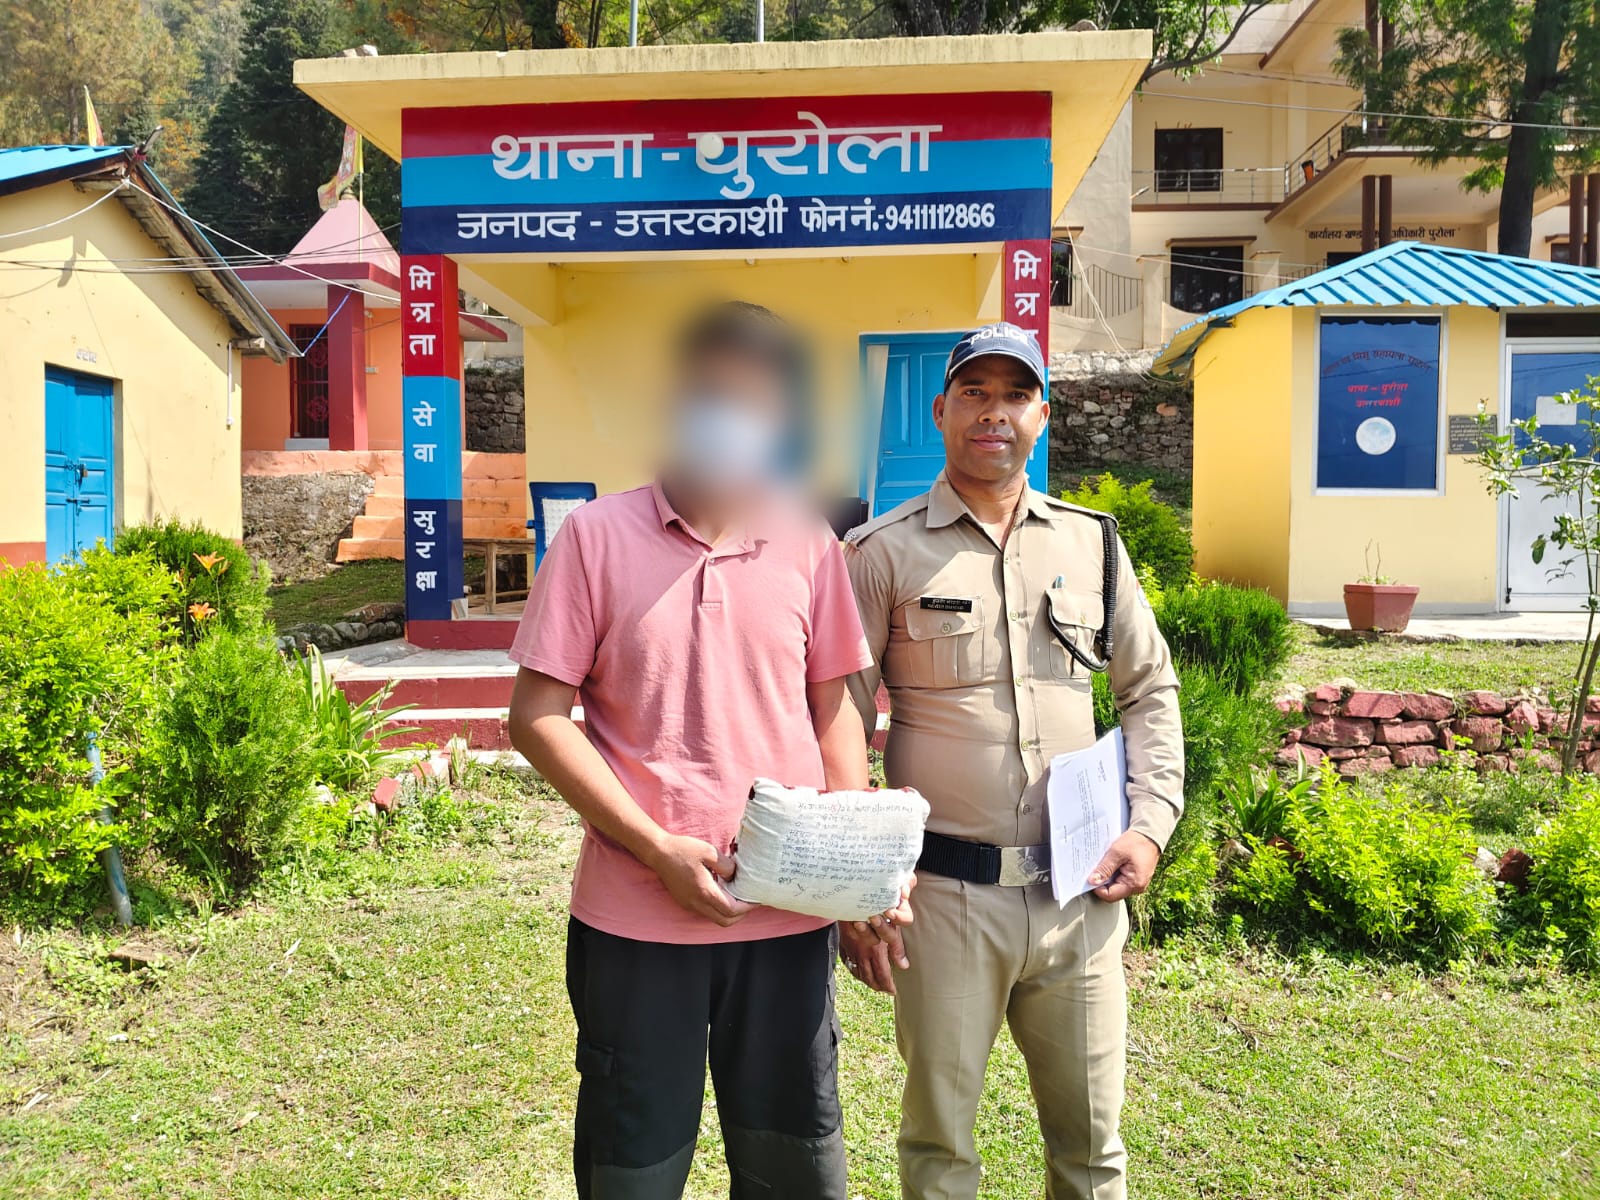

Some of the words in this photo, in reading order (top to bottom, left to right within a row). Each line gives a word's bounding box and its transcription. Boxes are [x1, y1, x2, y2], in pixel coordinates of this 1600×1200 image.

[491, 132, 654, 180] थाना
[687, 111, 943, 199] पुरोला
[456, 211, 582, 241] जनपद
[614, 194, 788, 237] उत्तरकाशी
[799, 197, 848, 232] फोन
[1429, 226, 1456, 241] पुरोला
